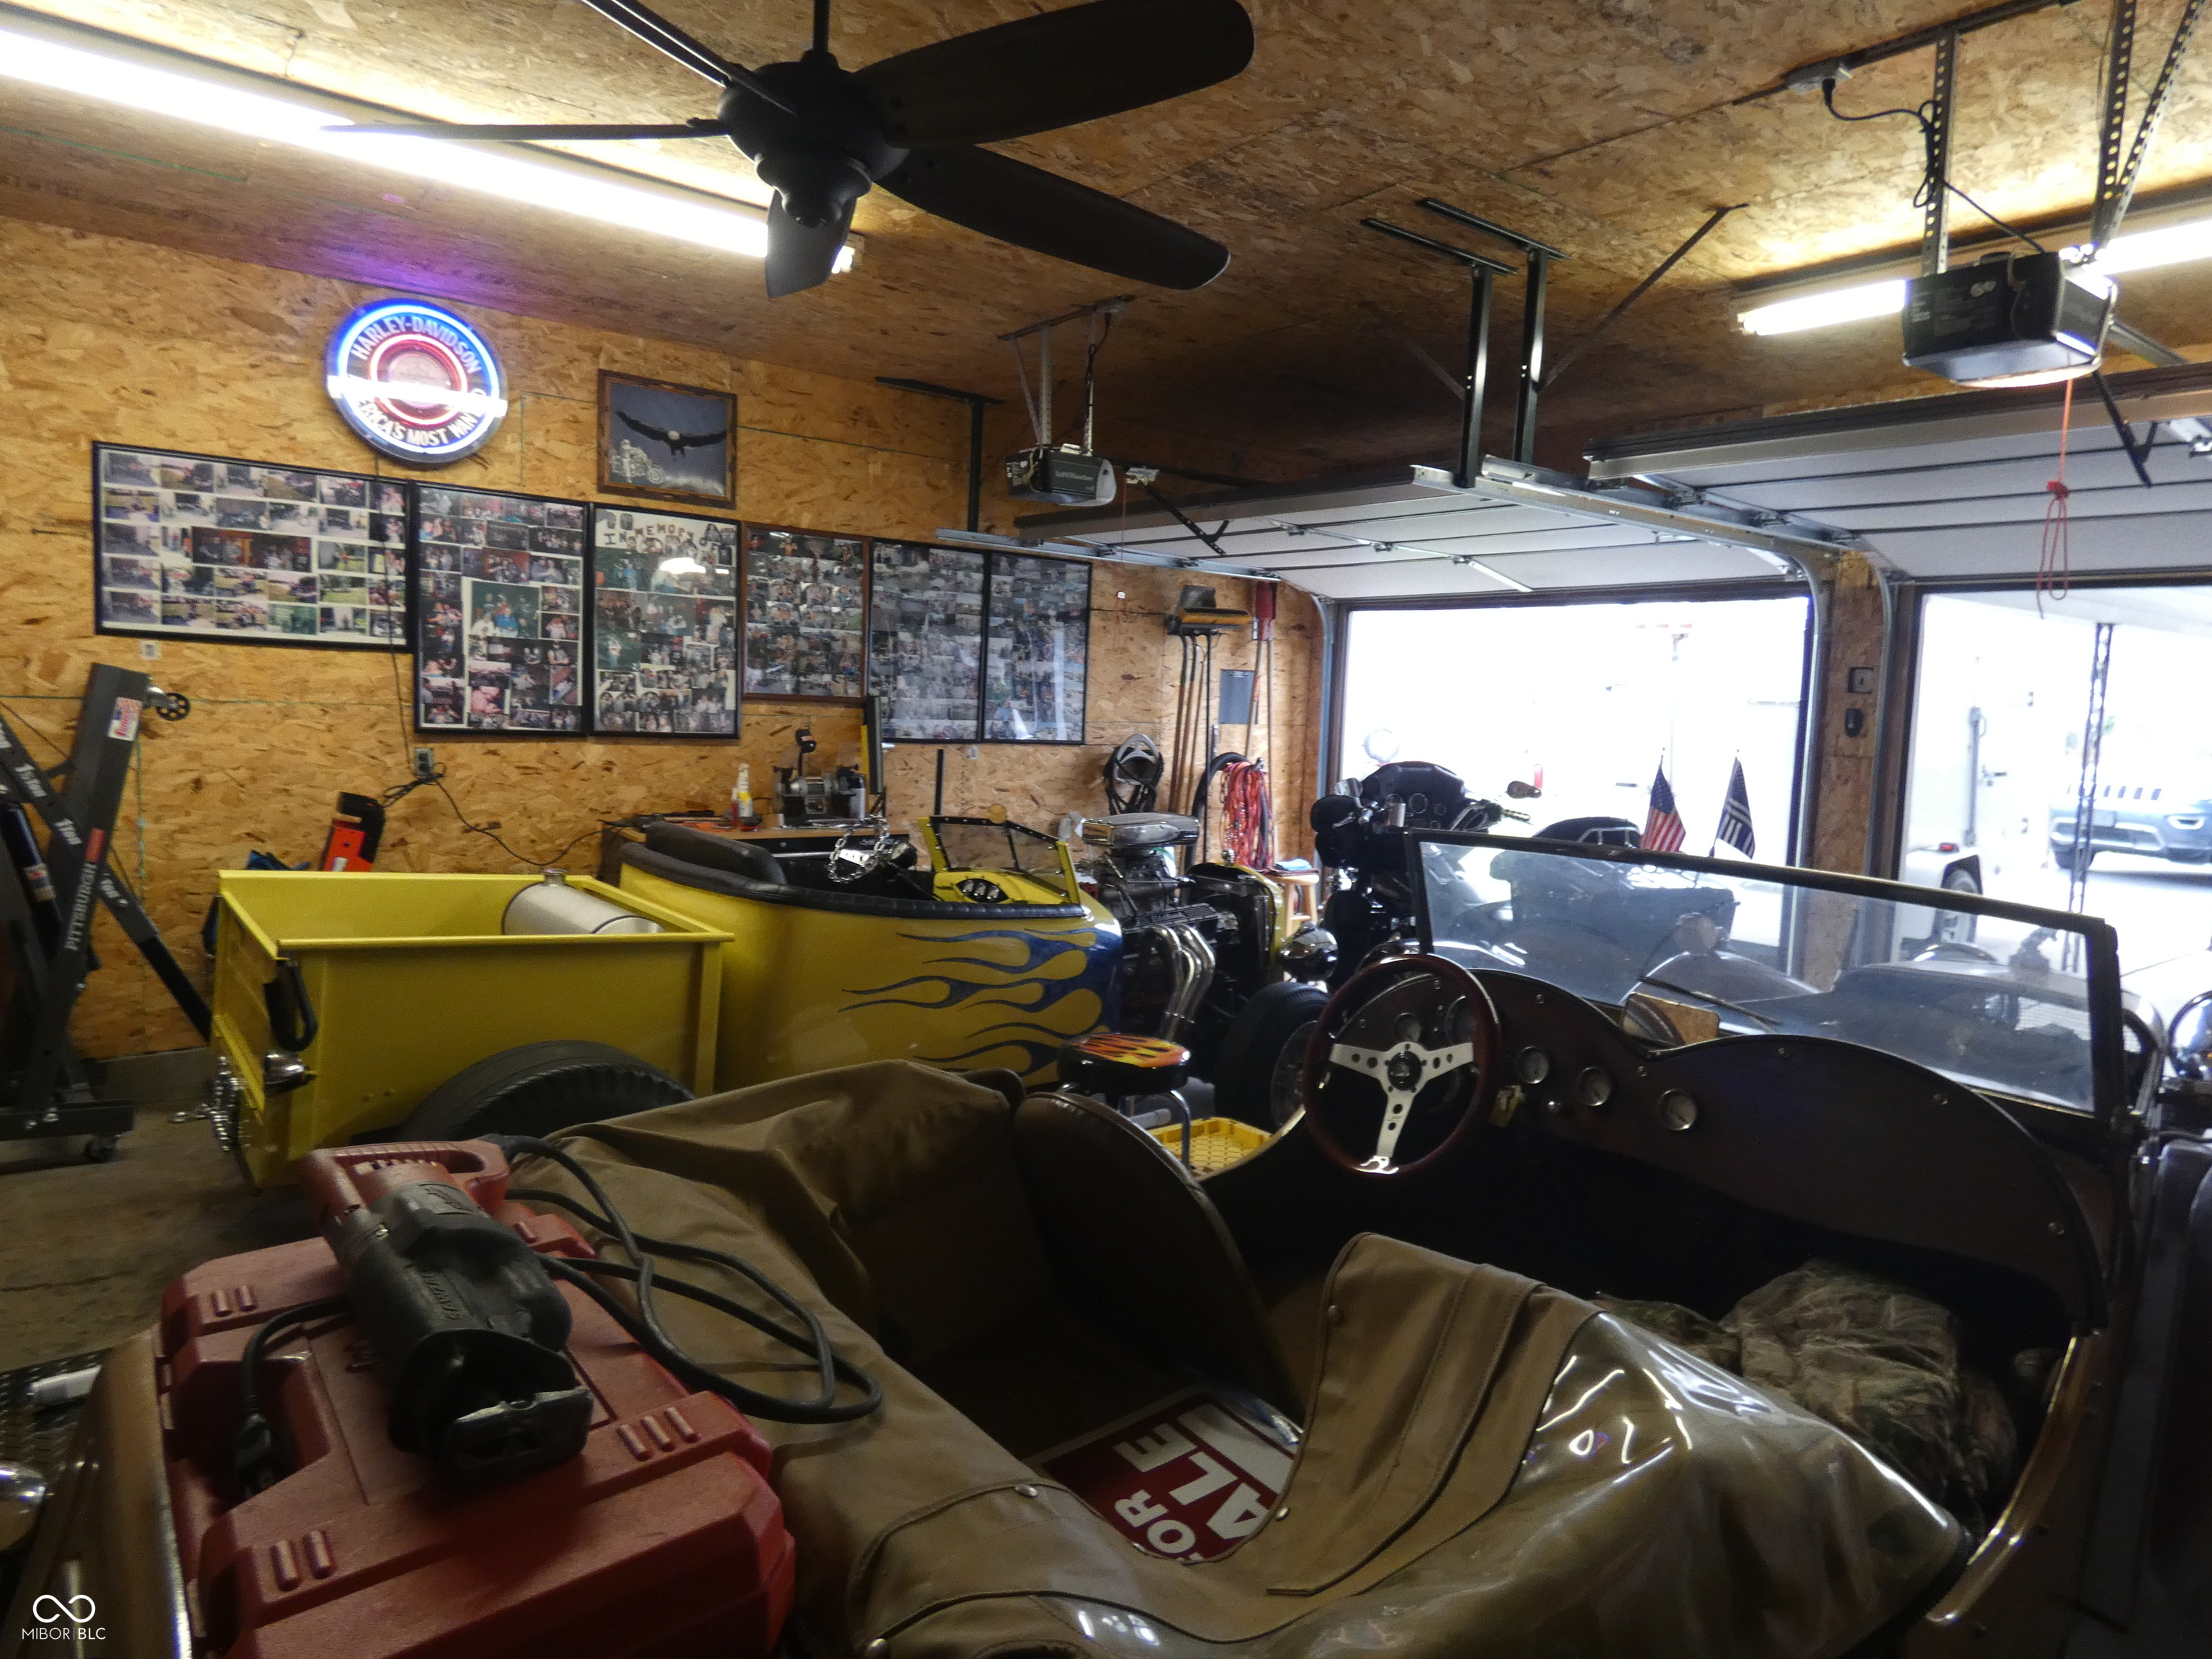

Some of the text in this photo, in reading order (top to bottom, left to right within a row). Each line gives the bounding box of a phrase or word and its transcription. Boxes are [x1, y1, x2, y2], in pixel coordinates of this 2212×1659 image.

[350, 315, 482, 374] HARLEY-DAVIDSON
[357, 397, 408, 441] RICA'S
[407, 428, 449, 446] MOST
[603, 531, 628, 546] IN
[634, 523, 694, 539] MEMORY
[63, 863, 99, 952] PITTSBURGH
[1112, 1422, 1270, 1540] ALE
[1113, 1489, 1202, 1561] OR
